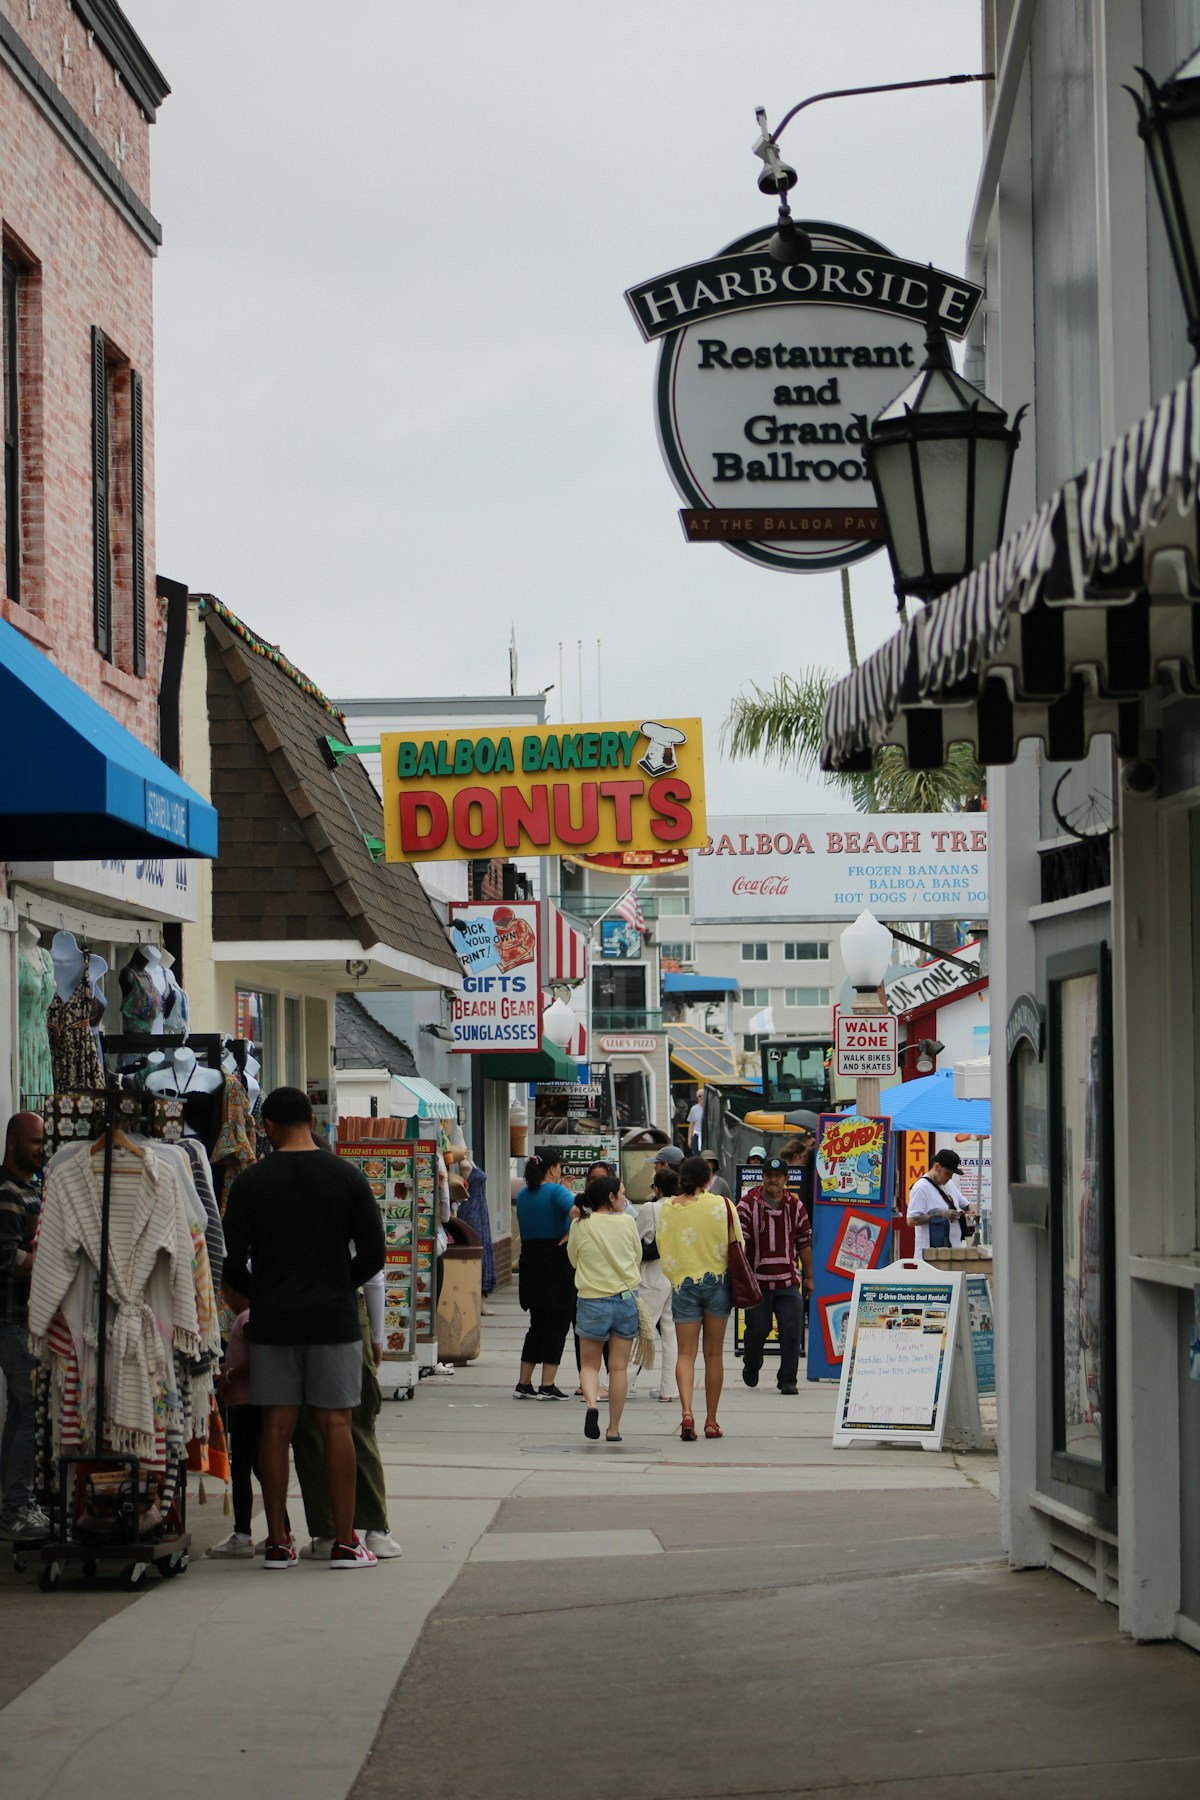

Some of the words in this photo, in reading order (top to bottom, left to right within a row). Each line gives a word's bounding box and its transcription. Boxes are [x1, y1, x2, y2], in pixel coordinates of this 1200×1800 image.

[640, 263, 970, 326] HARBORSIDE
[697, 339, 915, 369] Restaurant
[773, 377, 841, 406] and
[744, 415, 870, 445] Grand
[712, 452, 873, 482] Ballroo
[690, 519, 711, 530] AT
[721, 519, 753, 530] THE
[764, 517, 833, 530] BALBOA
[397, 736, 515, 778] BALBOA
[522, 730, 640, 772] BAKERY
[398, 778, 693, 852] DONUTS
[697, 832, 815, 856] BALBOA
[826, 831, 921, 854] BEACH
[848, 865, 902, 876] FROZEN
[908, 864, 979, 875] BANANAS
[731, 875, 791, 896] Coca-Cola
[869, 878, 926, 889] BALBOA
[932, 878, 970, 889] BARS
[834, 892, 864, 903] HOT
[869, 892, 907, 903] DOGS
[922, 891, 961, 902] CORN
[460, 923, 486, 939] PICK
[465, 935, 491, 948] YOUR
[493, 931, 517, 944] OWN
[459, 945, 491, 965] RINT!
[463, 976, 527, 993] GIFTS
[455, 997, 496, 1020] BEACH
[501, 997, 535, 1019] GEAR
[454, 1024, 537, 1041] SUNGLASSES
[845, 1022, 888, 1033] WALK
[633, 1039, 655, 1048] PIZZA
[846, 1036, 888, 1047] ZONE
[569, 1086, 601, 1094] SPECIAL
[340, 1147, 372, 1155] BREAKFAST
[373, 1147, 409, 1155] SANDWICHES
[909, 1131, 926, 1179] ATM
[391, 1255, 408, 1263] FRIES
[928, 1293, 948, 1301] Rentals!
